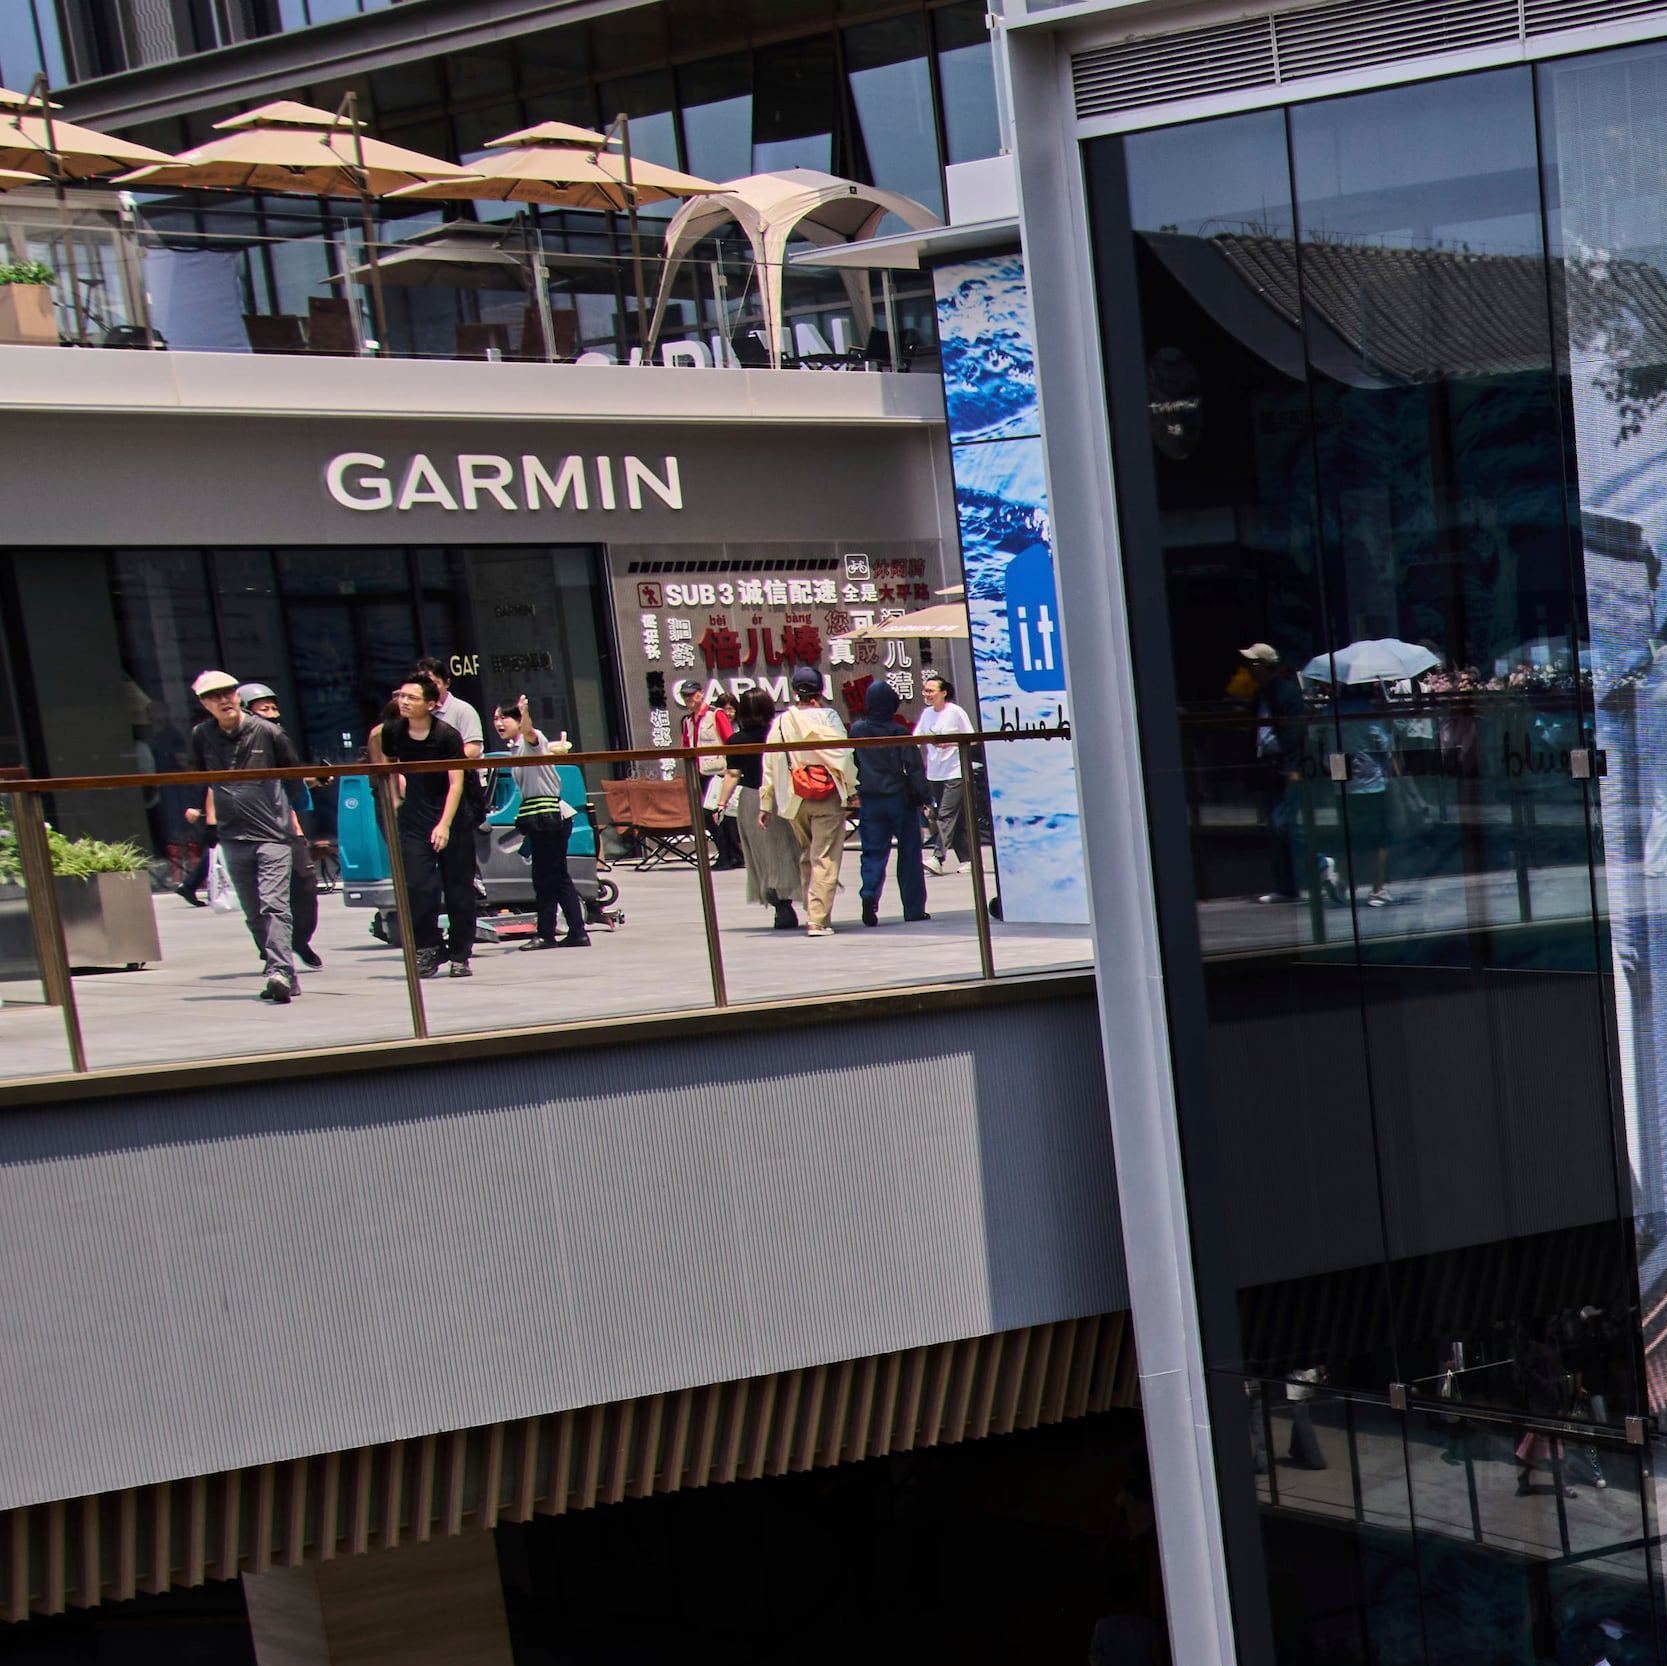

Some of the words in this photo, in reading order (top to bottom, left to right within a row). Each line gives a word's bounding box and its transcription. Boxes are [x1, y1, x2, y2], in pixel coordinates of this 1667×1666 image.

[326, 452, 683, 510] GARMIN
[665, 584, 716, 606] SUB
[718, 583, 734, 606] 3
[737, 579, 837, 605] 诚信配速
[699, 625, 823, 670] 倍儿棒
[1017, 605, 1054, 671] i.t
